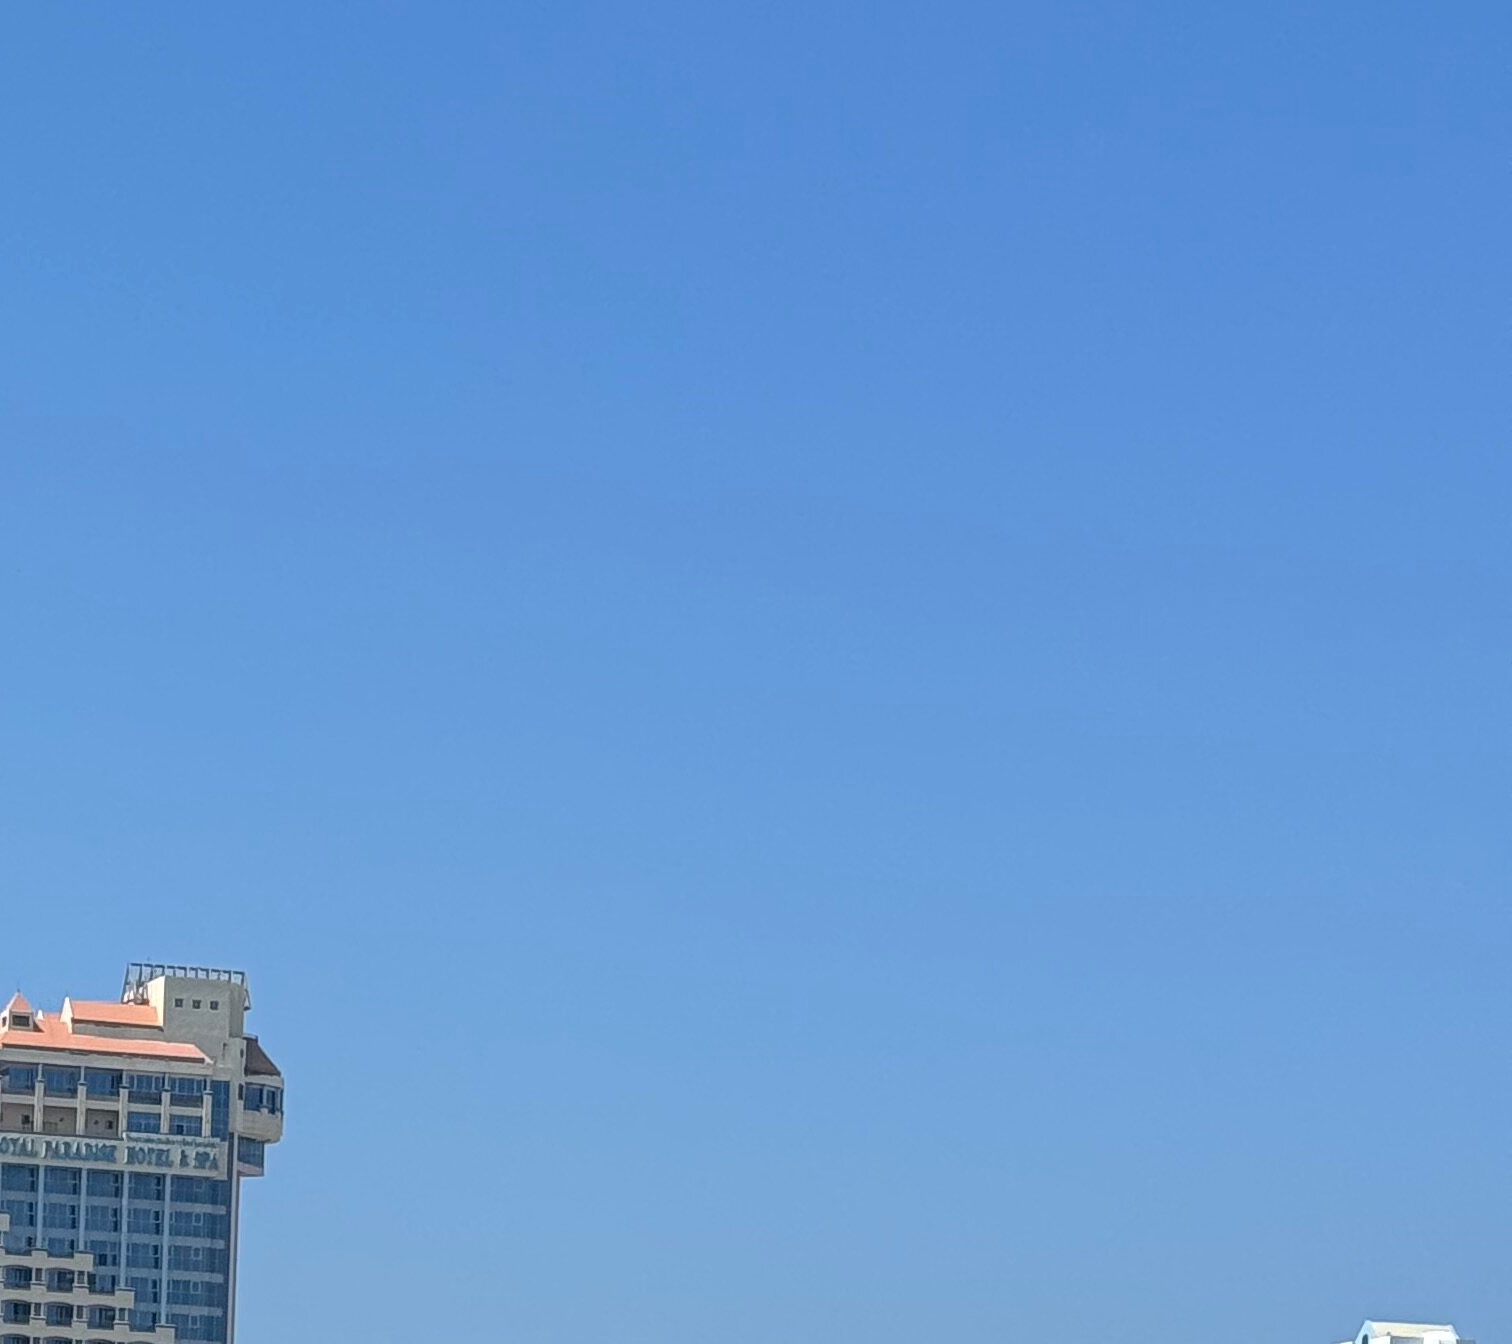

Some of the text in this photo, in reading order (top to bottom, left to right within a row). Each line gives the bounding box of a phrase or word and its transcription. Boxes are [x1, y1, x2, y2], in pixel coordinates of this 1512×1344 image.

[41, 1140, 117, 1162] PARADISE
[123, 1146, 173, 1168] HOTEL
[178, 1148, 189, 1168] &
[192, 1151, 219, 1170] SPA
